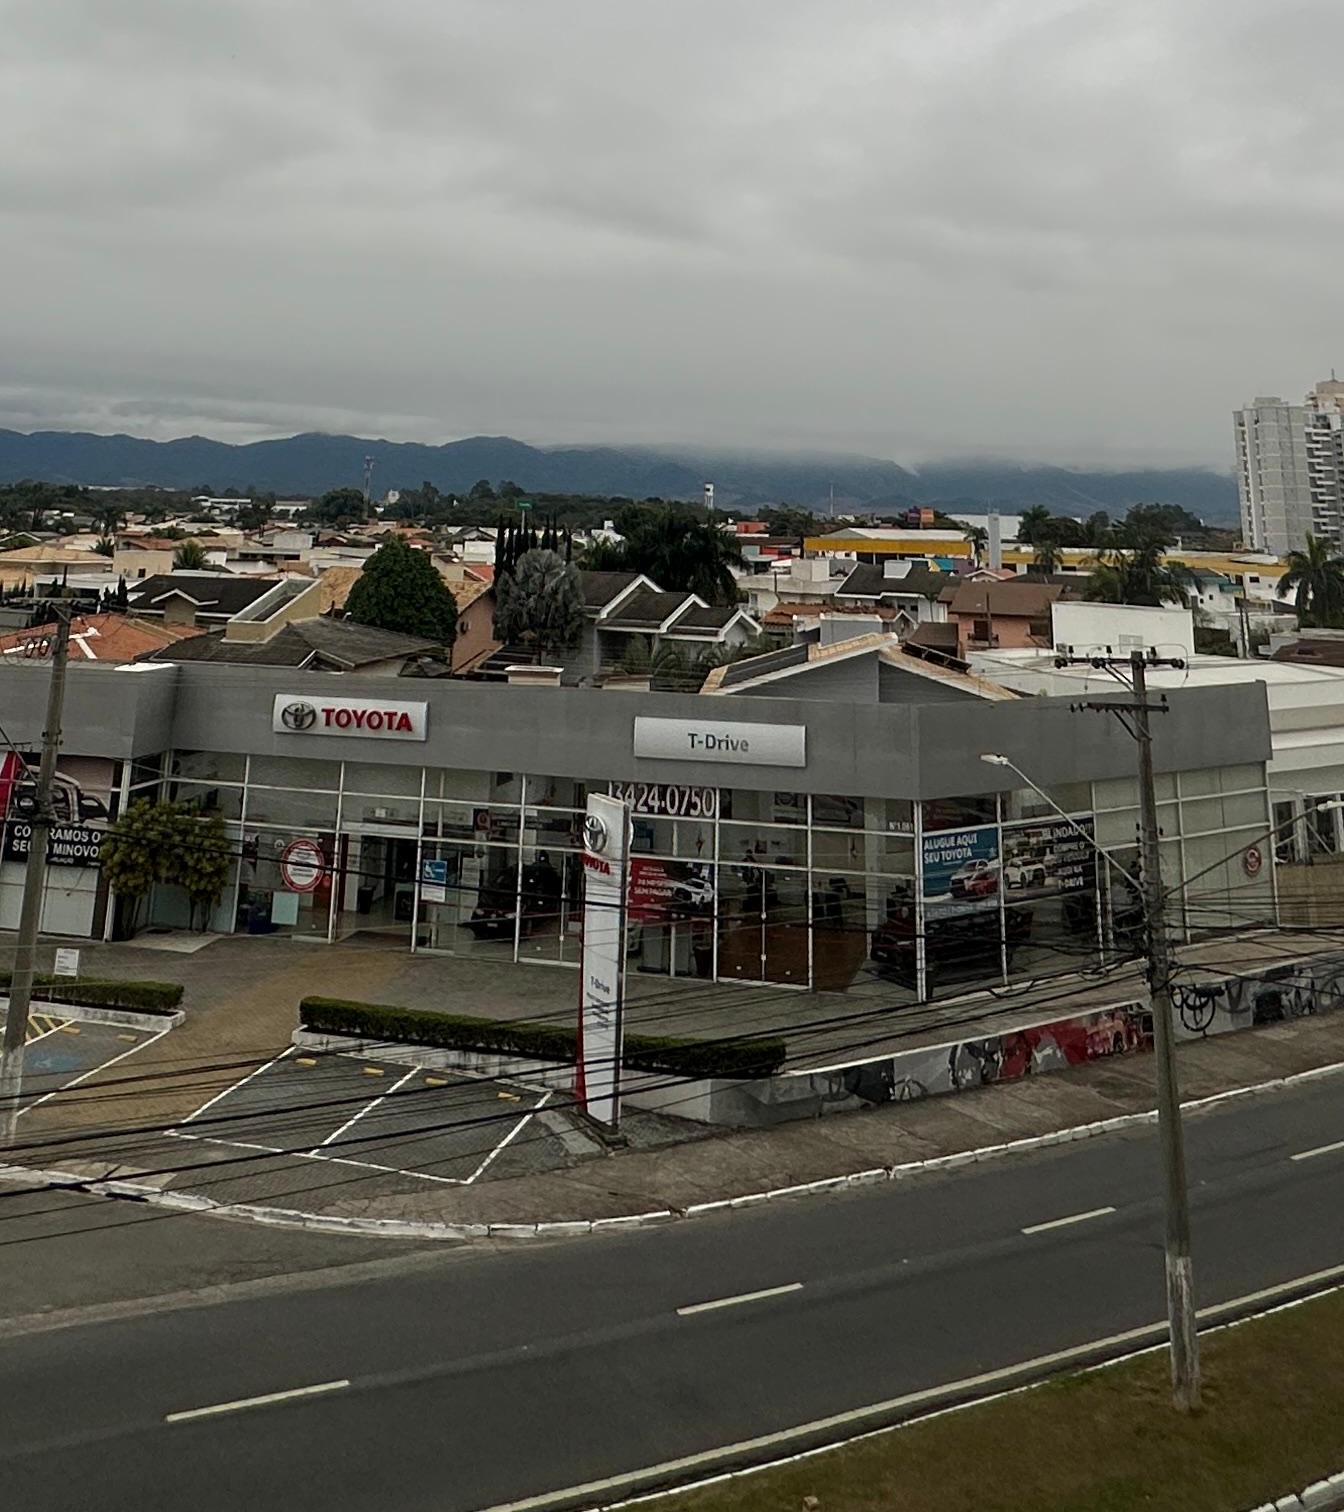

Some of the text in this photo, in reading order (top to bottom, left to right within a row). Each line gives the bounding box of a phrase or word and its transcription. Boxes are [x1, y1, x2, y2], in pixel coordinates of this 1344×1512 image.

[321, 708, 413, 732] TOYOTA
[687, 732, 750, 753] T-Drive
[14, 825, 101, 843] CORAMOS O
[923, 833, 977, 850] ALUGUE AQUI
[924, 847, 972, 864] SEU TOYOTA
